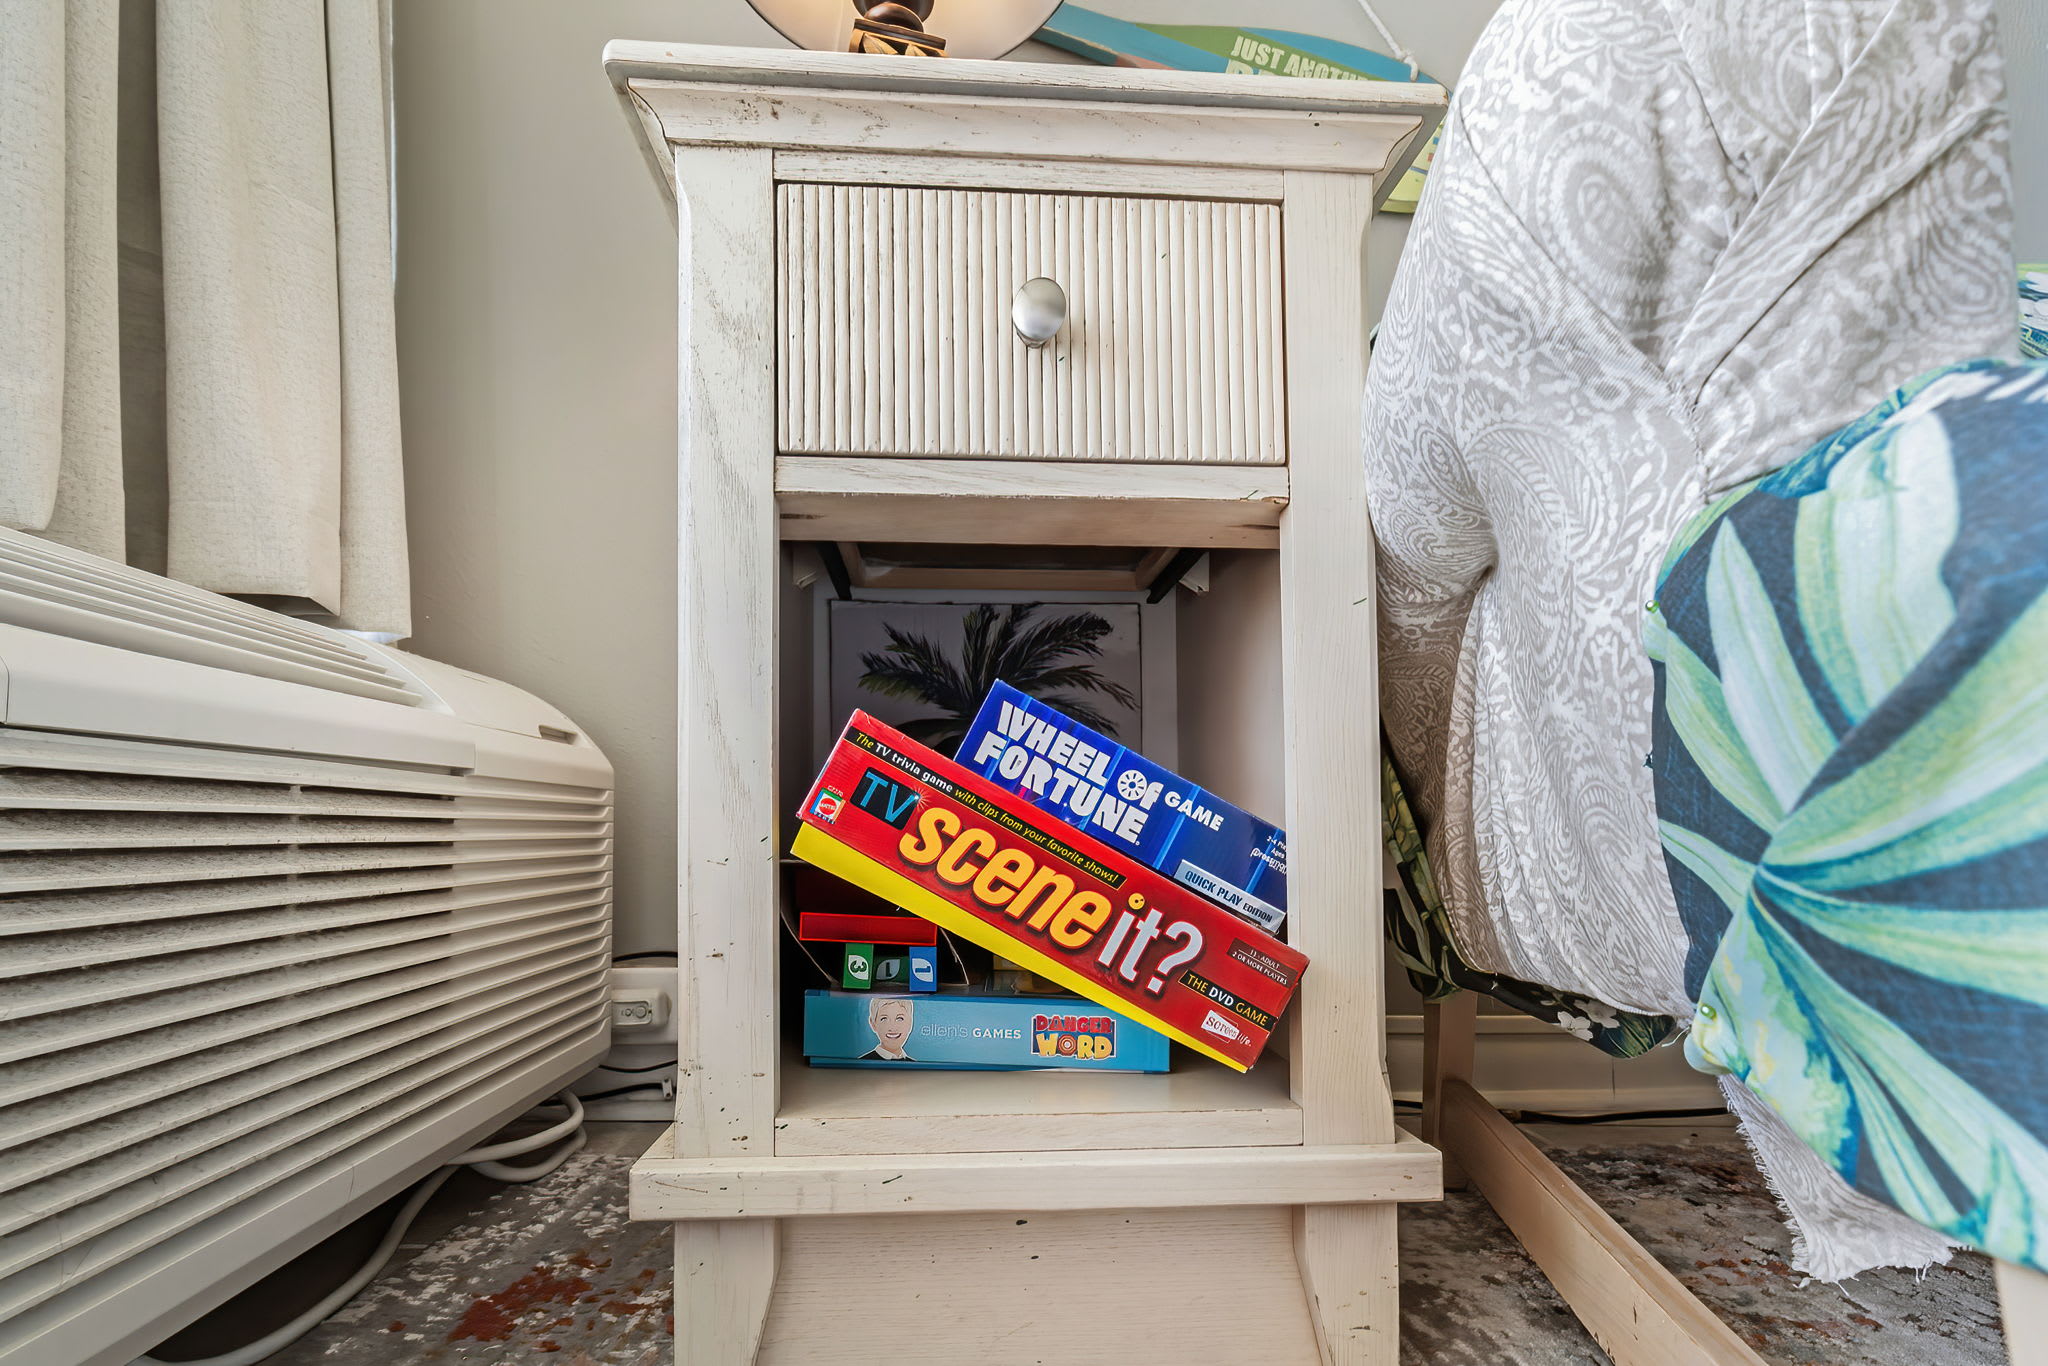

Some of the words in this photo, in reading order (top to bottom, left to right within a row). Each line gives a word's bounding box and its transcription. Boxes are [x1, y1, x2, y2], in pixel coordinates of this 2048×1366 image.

[1230, 35, 1285, 69] JUST
[997, 700, 1111, 788] WHEEL
[856, 732, 874, 749] The
[875, 743, 892, 757] TV
[892, 753, 920, 775] trivia
[922, 772, 953, 793] game
[954, 788, 977, 805] with
[978, 800, 999, 819] clips
[1000, 813, 1023, 831] from
[1023, 826, 1051, 847] your
[1047, 838, 1084, 865] favorite
[1084, 861, 1119, 884] shows!
[860, 771, 919, 823] TV
[973, 731, 1149, 844] FORTUNE
[1165, 791, 1224, 831] GAME
[899, 807, 1112, 949] scene
[1098, 893, 1203, 993] it?
[1185, 870, 1218, 893] QUICK
[1217, 886, 1243, 906] PLAY
[1243, 903, 1273, 923] EDITION
[1237, 954, 1246, 963] OR
[1246, 959, 1263, 972] MORE
[1263, 968, 1287, 985] PLAYERS
[1035, 1014, 1112, 1033] DANGER
[1187, 974, 1208, 993] THE
[1208, 986, 1234, 1007] DVD
[1235, 1002, 1268, 1026] GAME
[920, 1023, 968, 1038] ellen's
[972, 1027, 1022, 1040] GAMES
[1035, 1033, 1113, 1059] WORD
